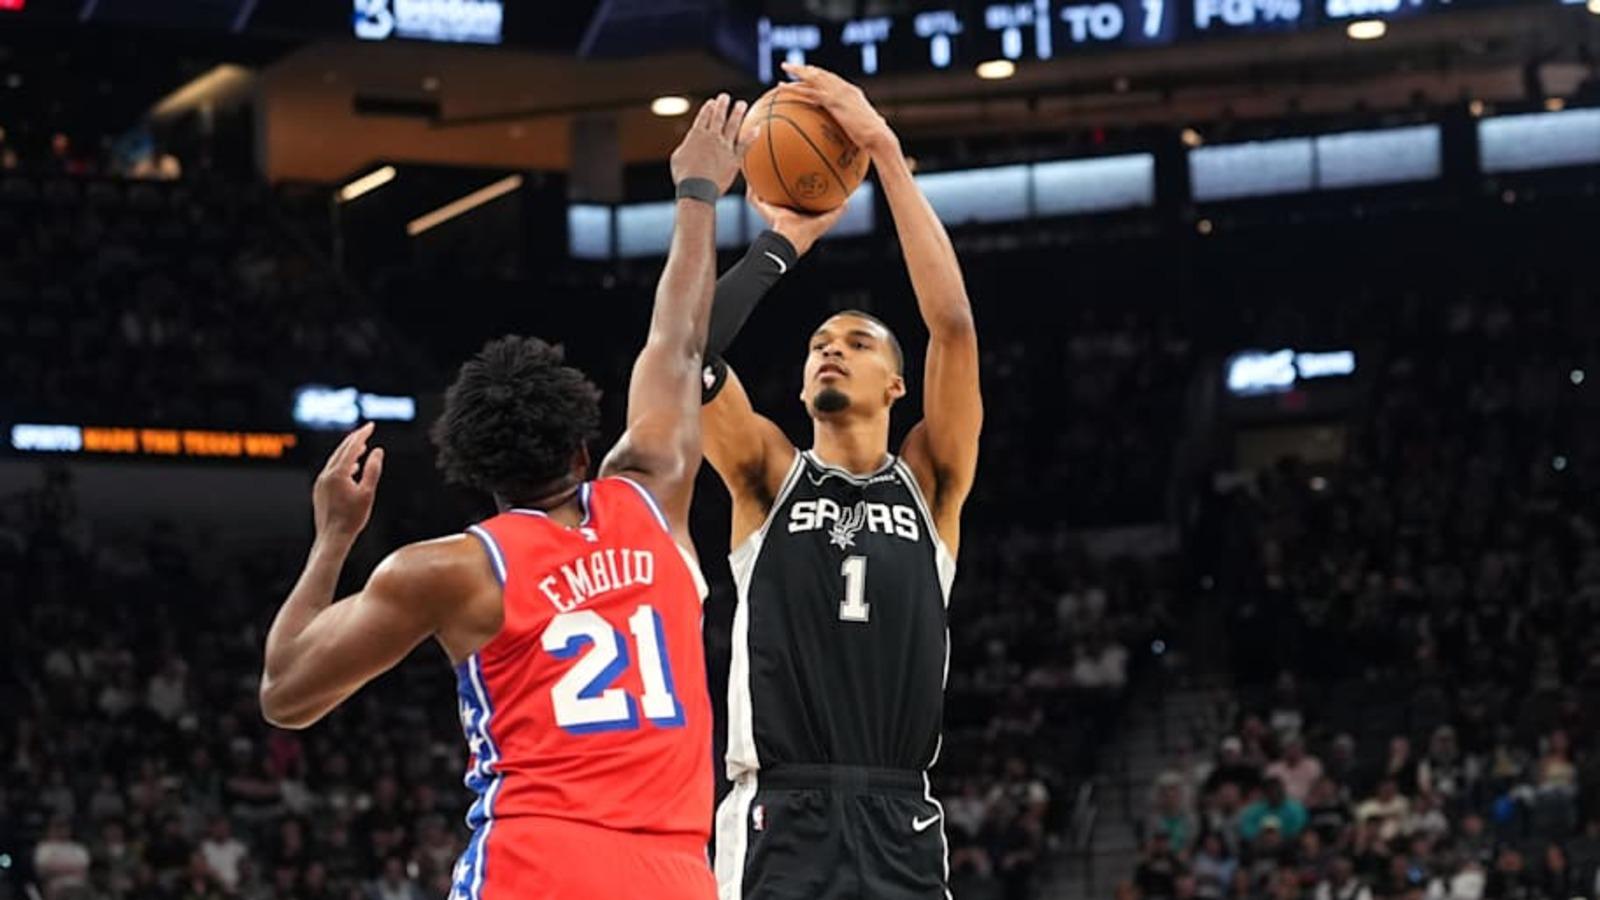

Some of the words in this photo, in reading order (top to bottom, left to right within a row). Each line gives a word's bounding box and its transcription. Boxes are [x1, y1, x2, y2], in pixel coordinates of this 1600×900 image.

[1061, 3, 1124, 42] TO
[788, 498, 920, 549] SPURS
[539, 548, 654, 613] EMBIID
[839, 555, 870, 622] 1
[541, 604, 686, 734] 21
